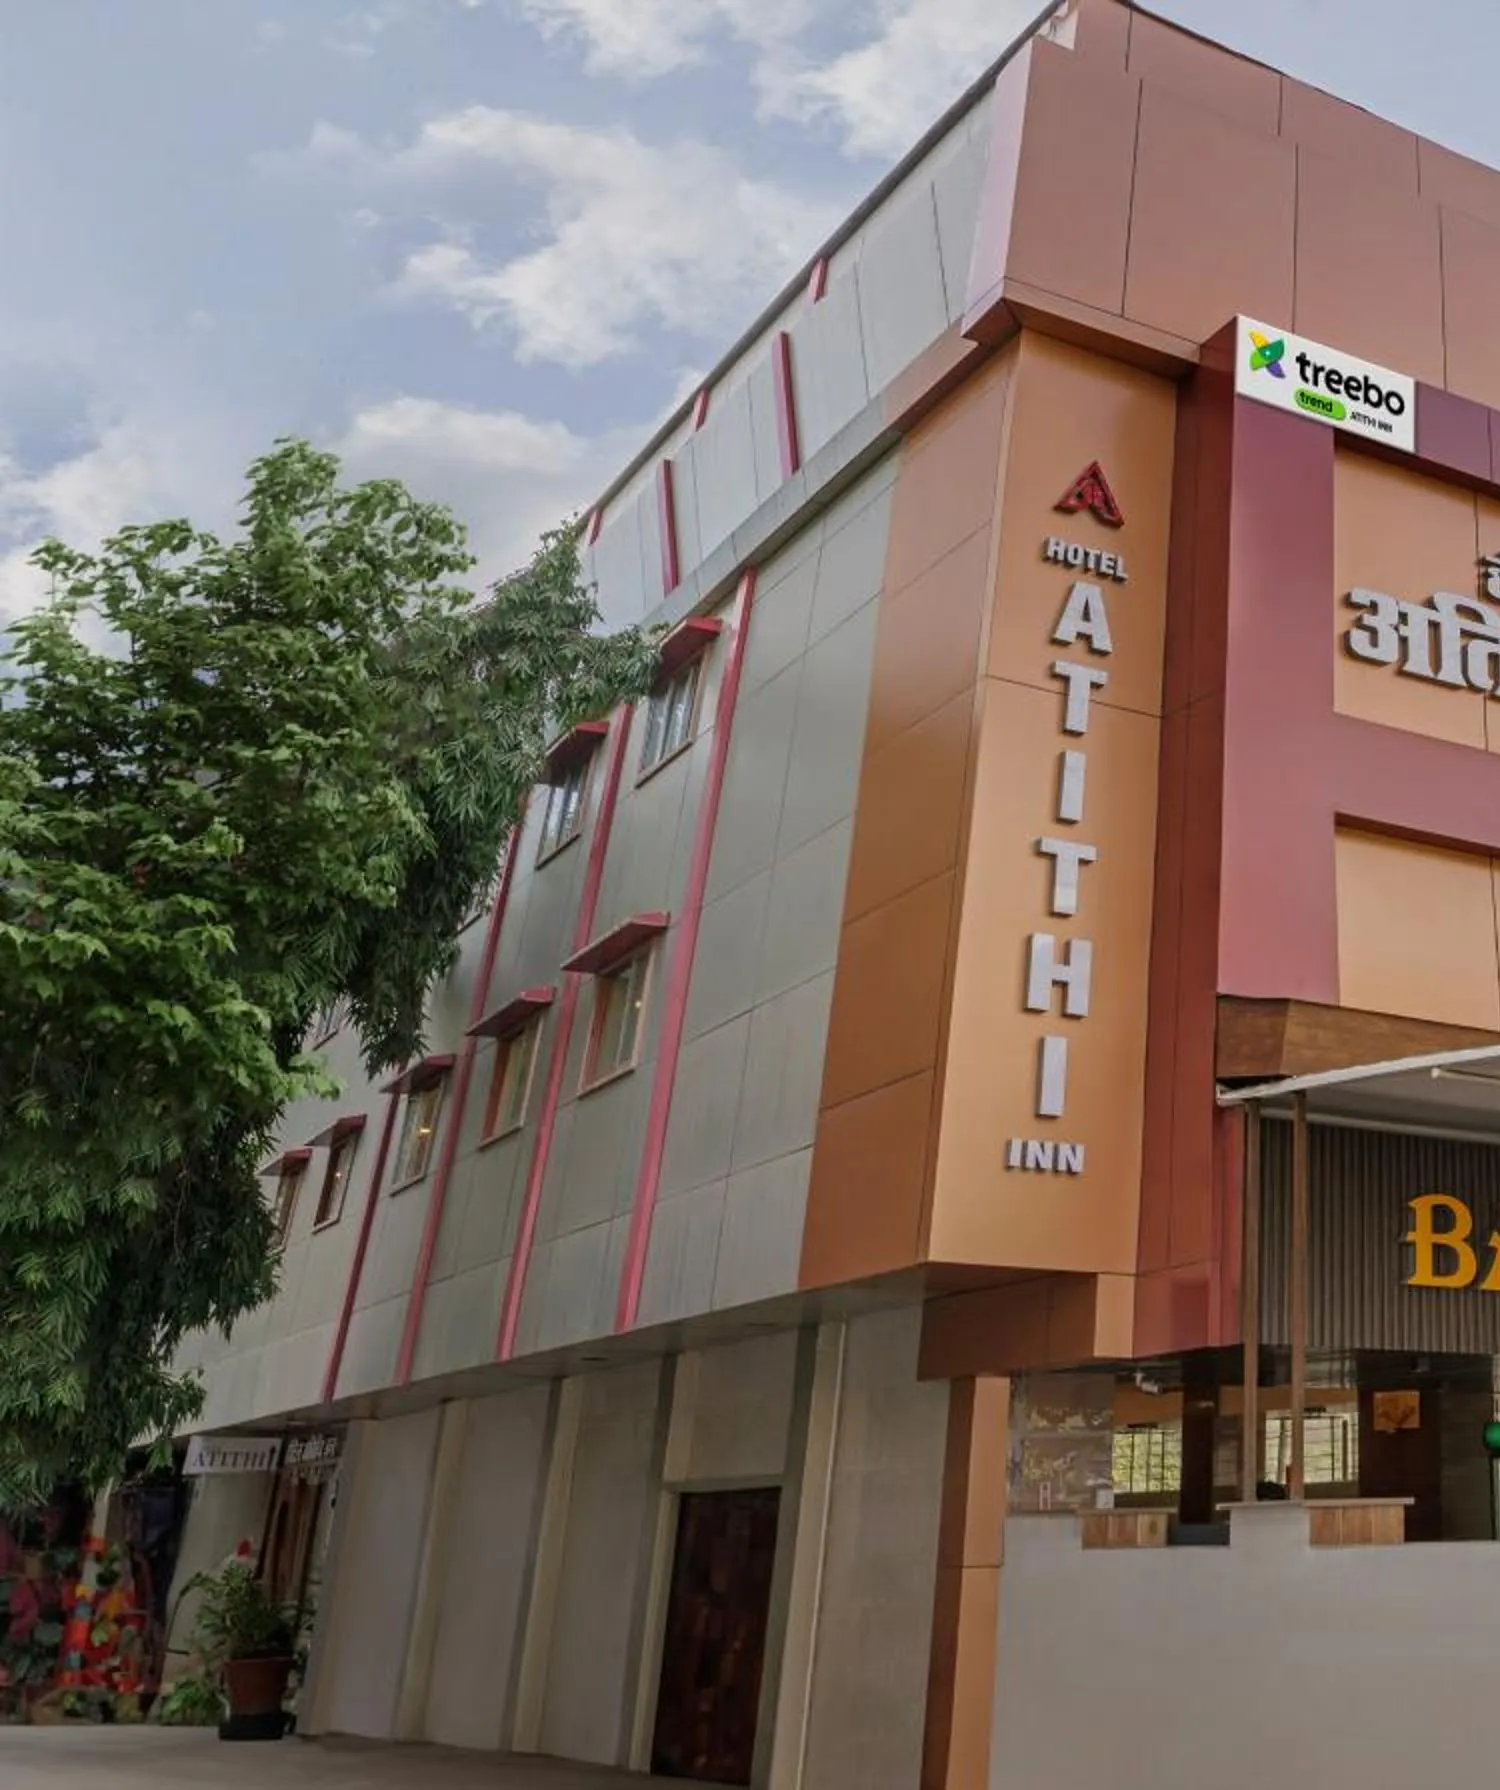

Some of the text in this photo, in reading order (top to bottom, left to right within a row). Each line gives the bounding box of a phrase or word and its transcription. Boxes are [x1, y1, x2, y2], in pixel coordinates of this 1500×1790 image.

[1296, 351, 1405, 416] treebo
[1299, 391, 1334, 413] trend
[1045, 536, 1129, 580] HOTEL
[1024, 581, 1113, 1119] ATITHI
[1007, 1137, 1085, 1174] INN
